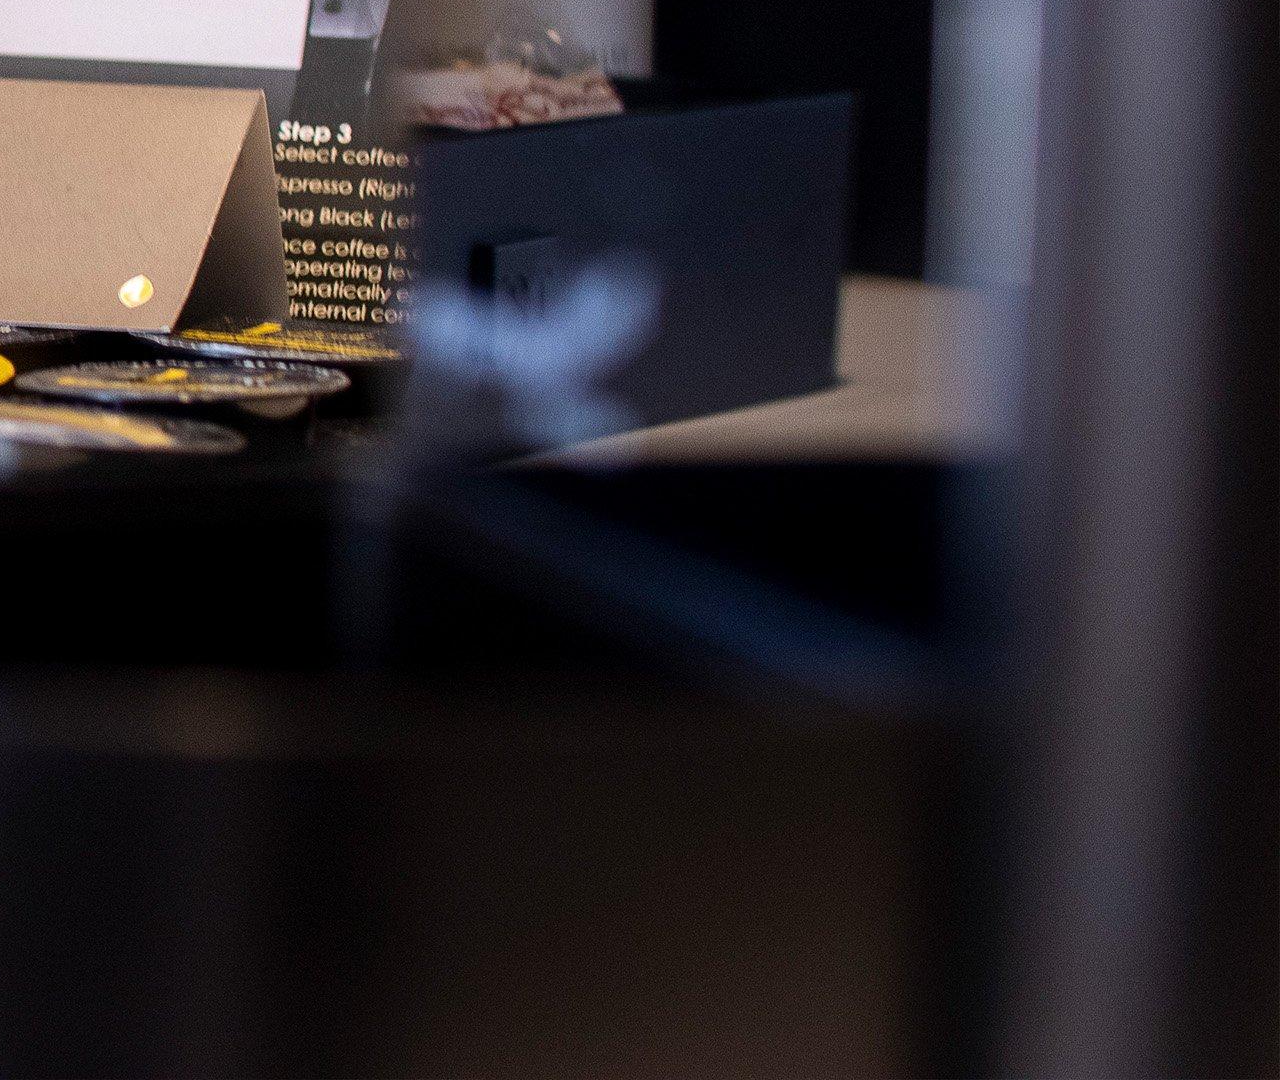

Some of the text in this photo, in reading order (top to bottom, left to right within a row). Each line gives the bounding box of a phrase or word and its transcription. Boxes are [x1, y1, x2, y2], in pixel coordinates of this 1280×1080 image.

[279, 120, 352, 145] Step 3
[275, 143, 409, 167] Select coffee
[276, 175, 353, 197] spresso
[279, 207, 314, 228] ong
[320, 207, 374, 228] Black
[321, 239, 389, 259] coffee
[288, 281, 391, 304] omatically
[290, 301, 366, 322] internal
